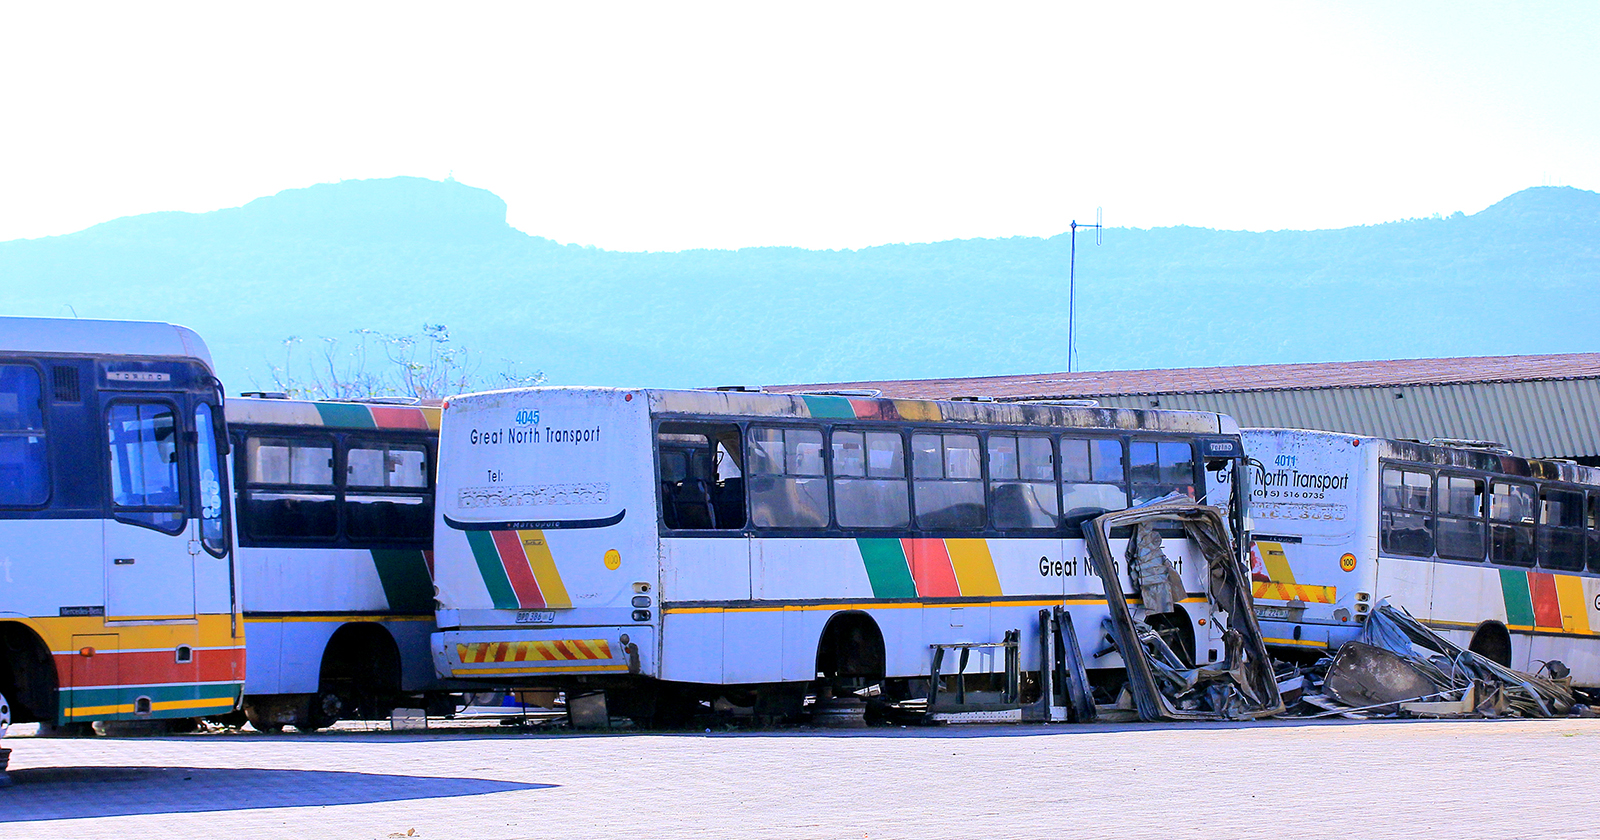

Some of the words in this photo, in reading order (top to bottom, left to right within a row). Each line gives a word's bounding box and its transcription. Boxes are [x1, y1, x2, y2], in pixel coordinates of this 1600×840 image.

[515, 410, 540, 425] 4045
[470, 428, 503, 445] Great
[508, 428, 540, 444] North
[545, 426, 601, 445] Transport
[1274, 455, 1296, 466] 4011
[487, 470, 504, 482] Tel:
[1255, 469, 1288, 486] North
[1292, 470, 1349, 492] Transport
[606, 554, 619, 565] 100
[1343, 558, 1354, 566] 100
[1039, 556, 1077, 577] Great
